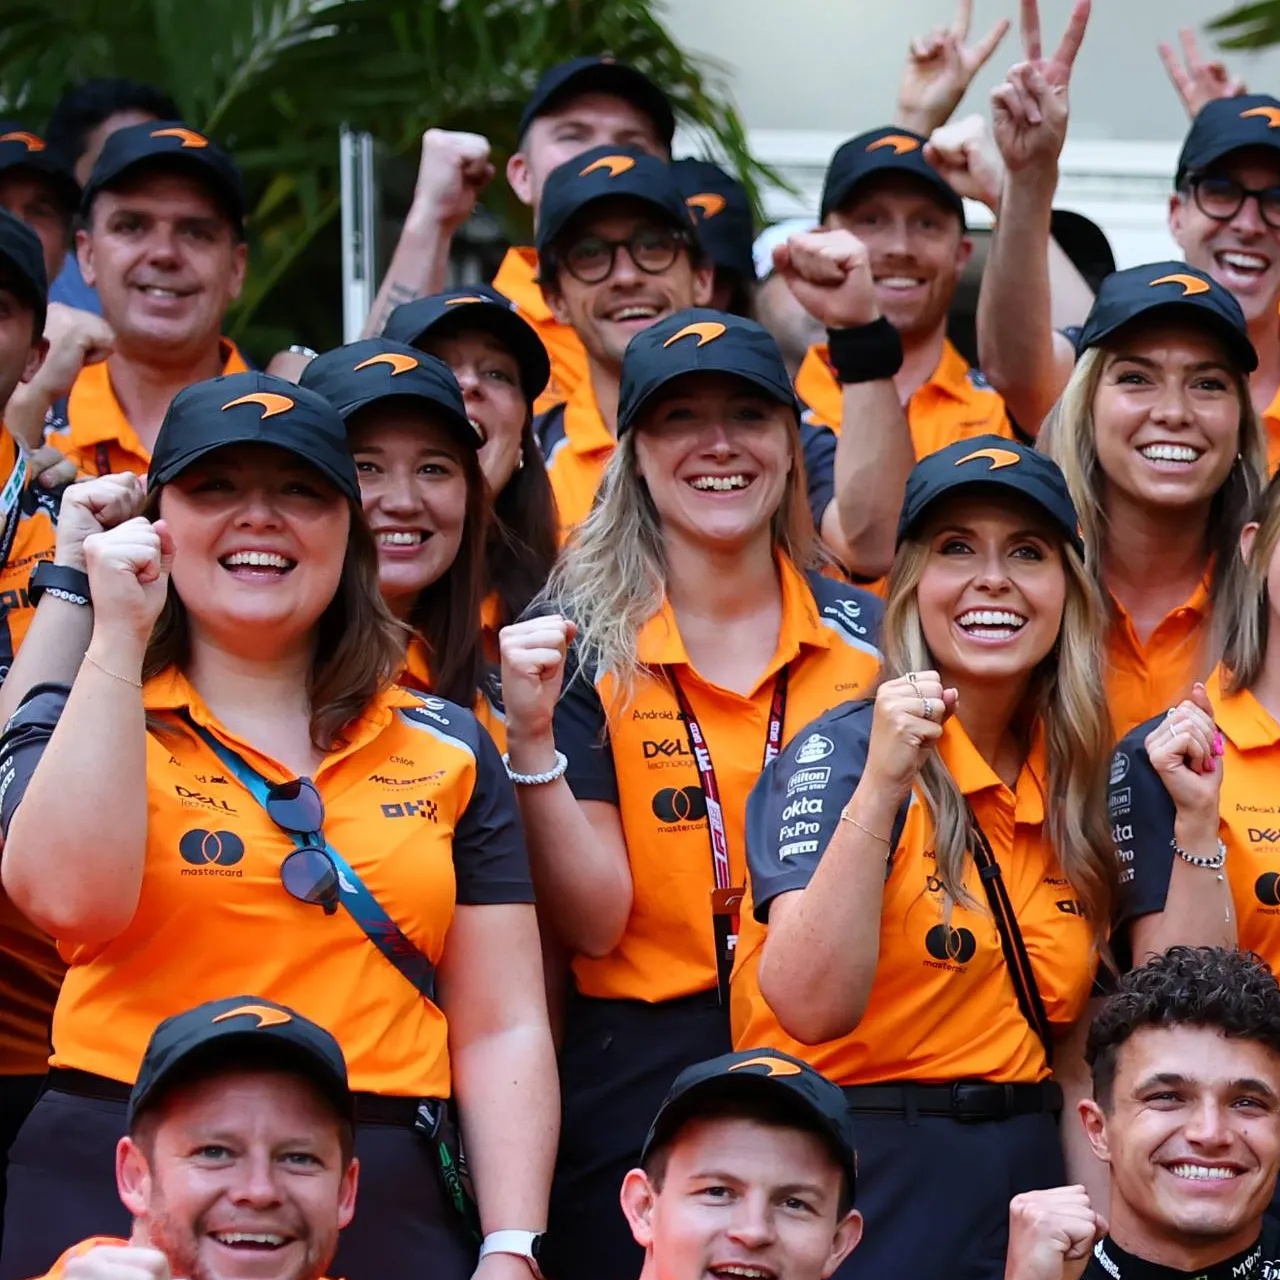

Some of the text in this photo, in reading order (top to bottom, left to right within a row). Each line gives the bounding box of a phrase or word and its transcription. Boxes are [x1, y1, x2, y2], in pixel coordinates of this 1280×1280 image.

[632, 710, 674, 720] Android
[388, 755, 415, 768] Chloe
[368, 774, 438, 786] McLaren
[790, 771, 824, 787] Hilton
[380, 799, 438, 823] OKX
[782, 797, 823, 821] okta
[1236, 803, 1276, 814] Android
[779, 821, 820, 842] FxPro
[180, 867, 243, 878] mastercard
